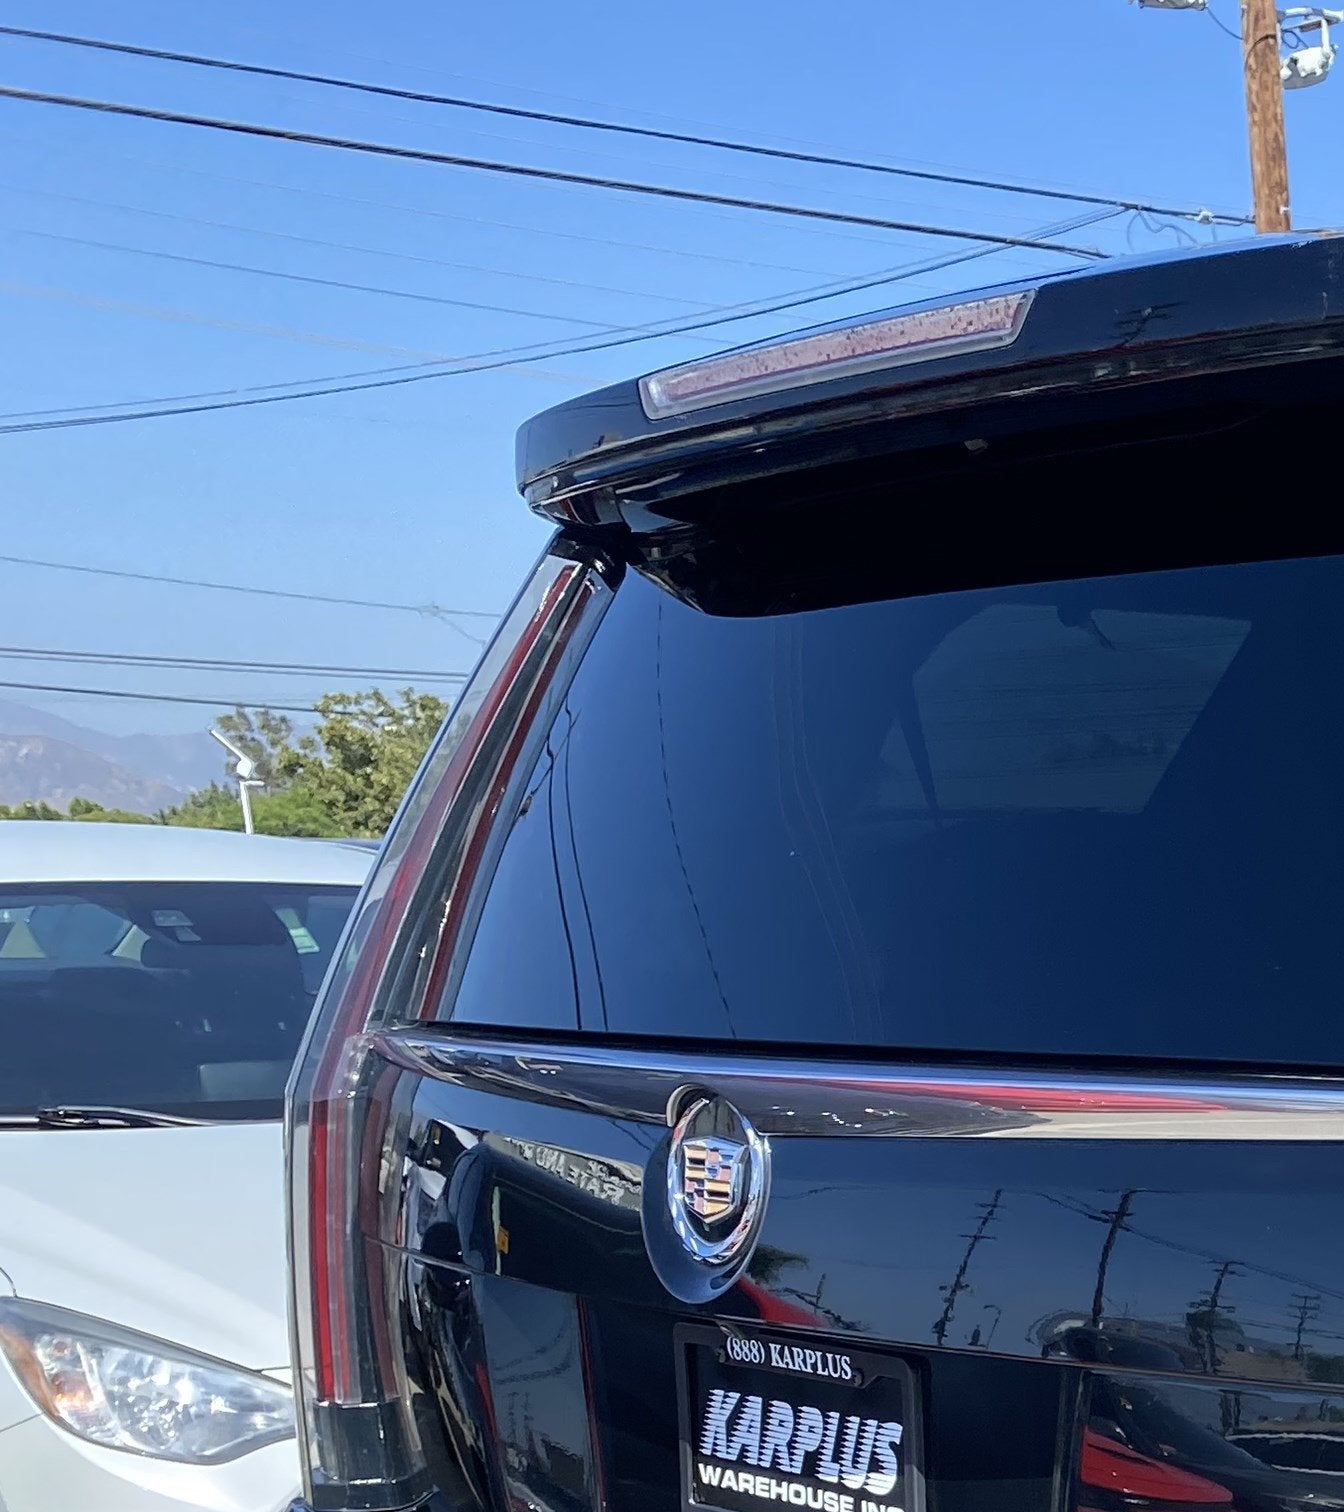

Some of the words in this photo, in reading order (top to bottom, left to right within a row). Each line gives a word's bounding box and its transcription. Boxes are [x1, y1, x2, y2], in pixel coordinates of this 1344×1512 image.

[726, 1335, 765, 1364] (888)
[768, 1343, 852, 1380] KARPLUS
[699, 1388, 904, 1496] KARPLUS
